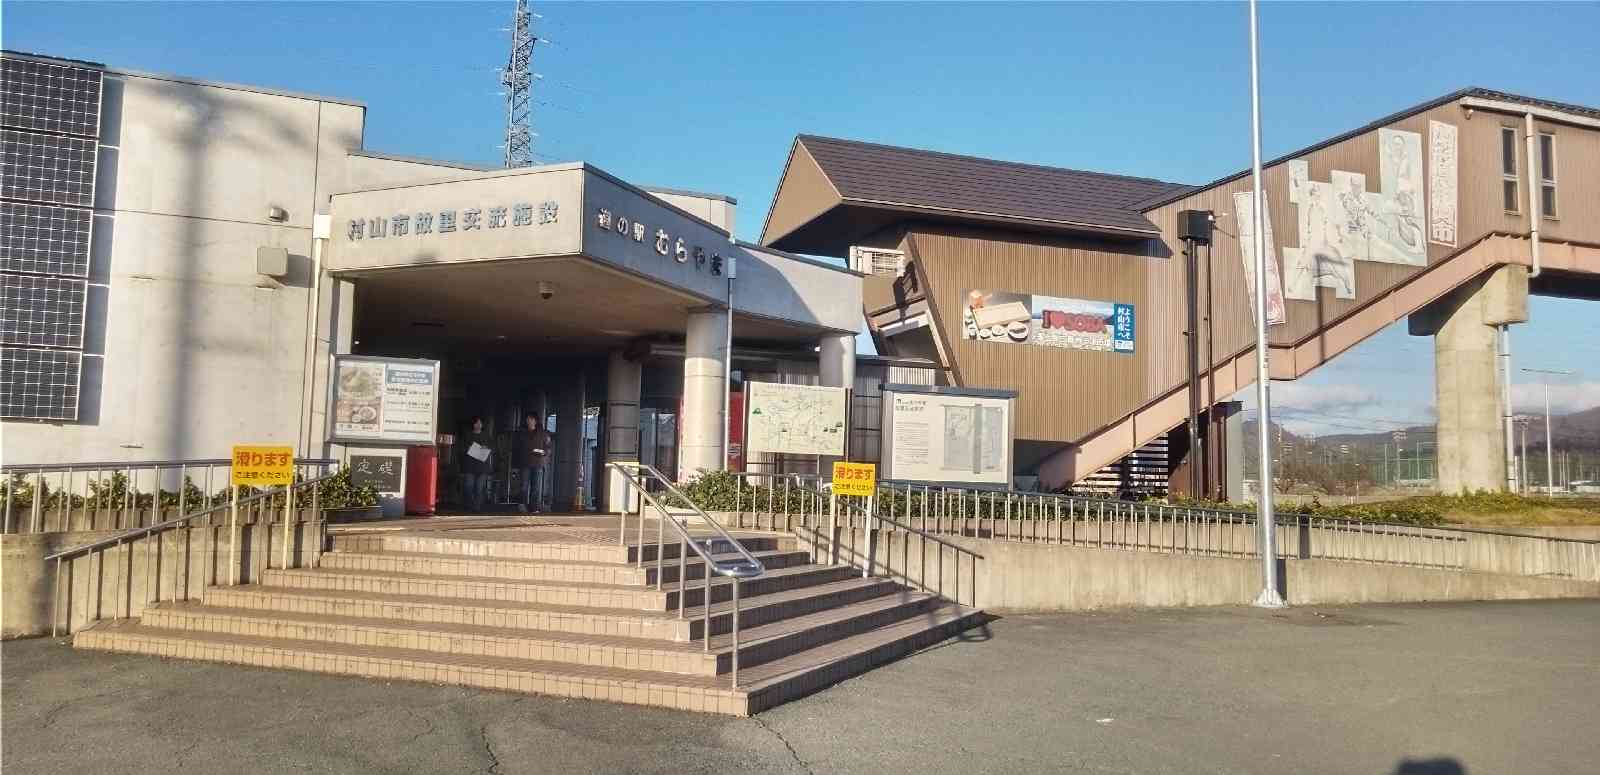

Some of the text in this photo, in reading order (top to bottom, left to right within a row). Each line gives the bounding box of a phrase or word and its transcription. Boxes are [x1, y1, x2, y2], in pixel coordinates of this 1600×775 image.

[348, 200, 559, 241] 村山市故里交流施設
[598, 207, 722, 276] 道の駅 むらやま
[235, 451, 292, 467] 滑ります
[234, 471, 292, 479] ご注意ください
[834, 465, 875, 481] 滑ります
